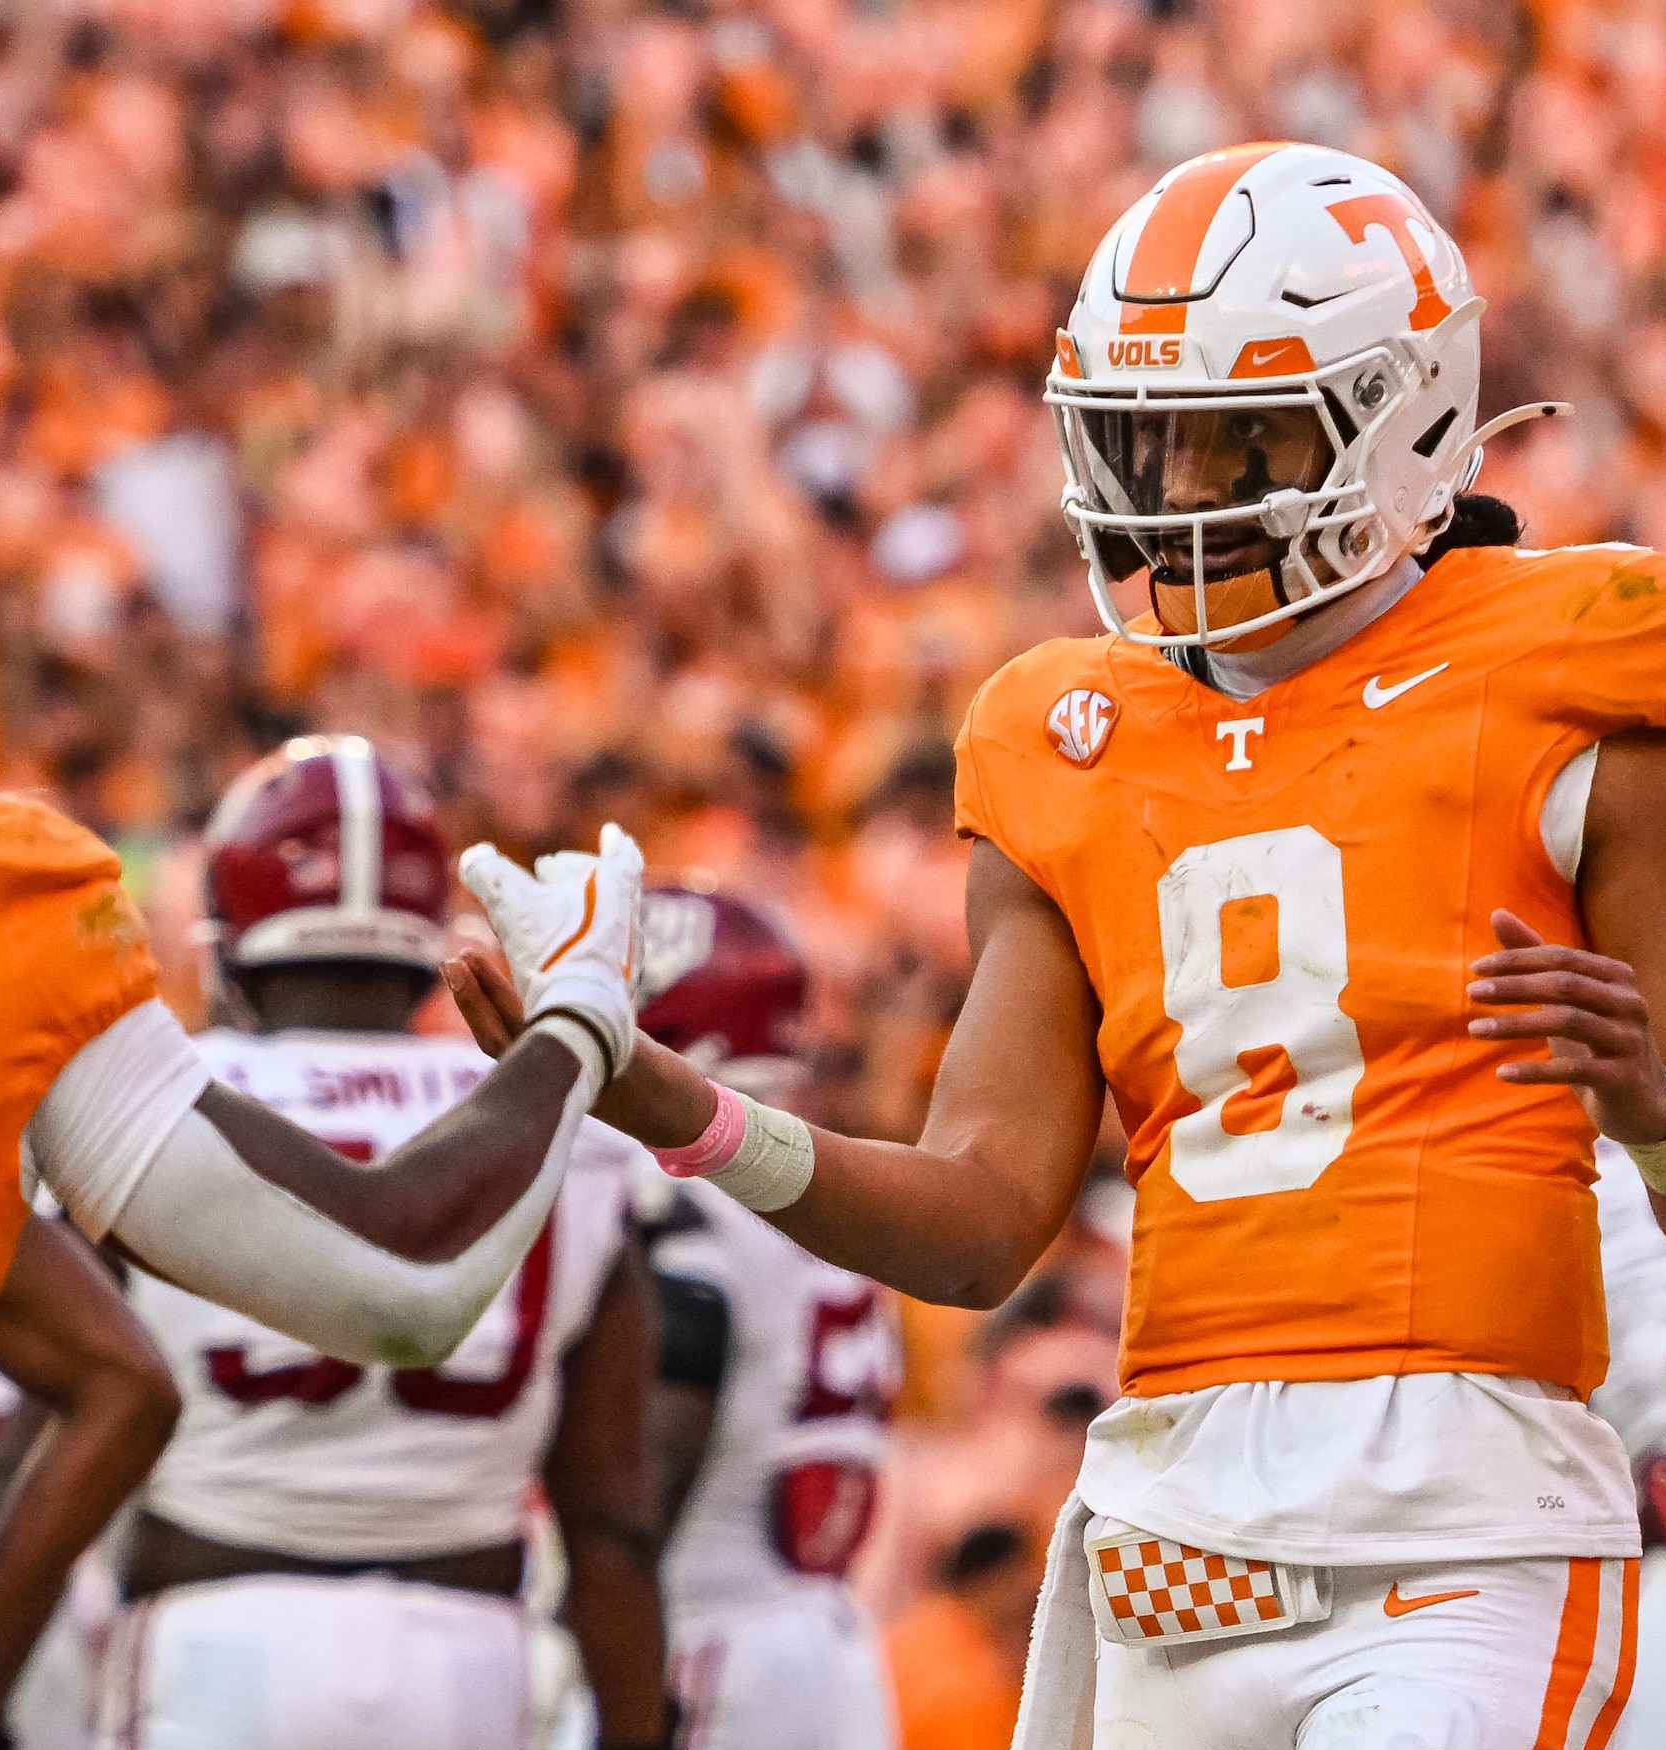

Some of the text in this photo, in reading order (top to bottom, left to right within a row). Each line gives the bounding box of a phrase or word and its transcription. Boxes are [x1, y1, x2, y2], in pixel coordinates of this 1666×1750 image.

[1323, 194, 1453, 331] T
[1108, 339, 1181, 368] VOLS
[1047, 691, 1116, 766] SEC
[1215, 716, 1265, 772] T
[1156, 824, 1366, 1203] 8
[701, 1100, 732, 1153] Cancer
[1536, 1494, 1565, 1510] DSG
